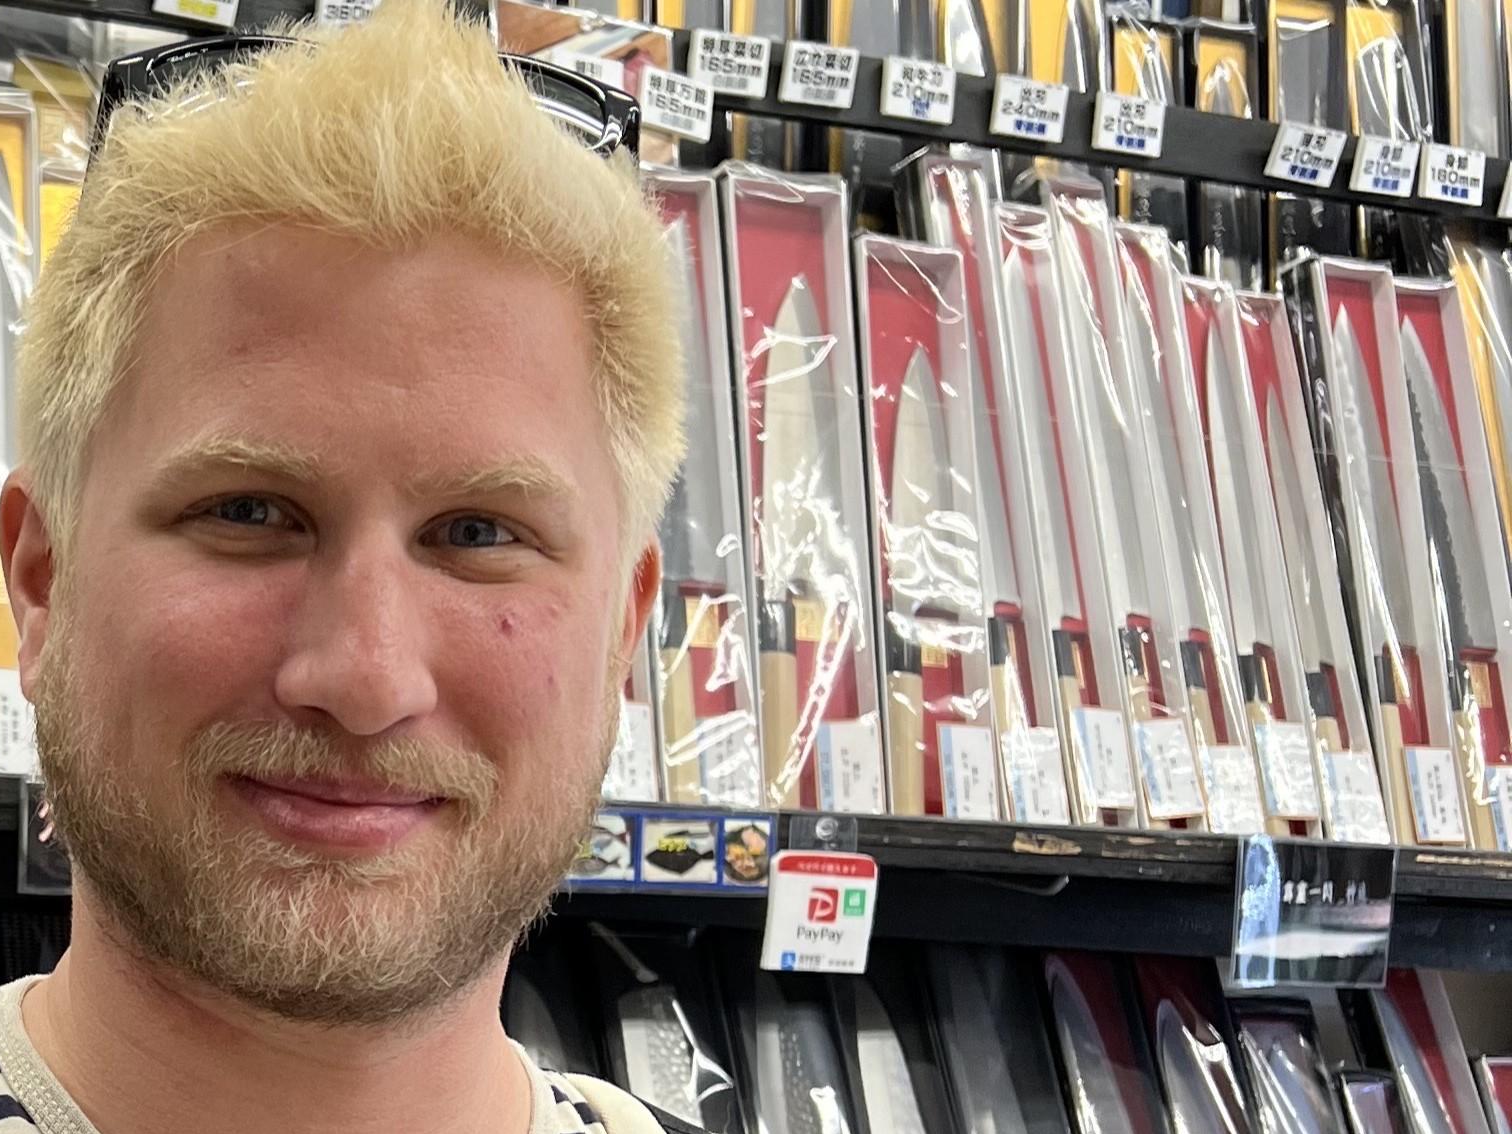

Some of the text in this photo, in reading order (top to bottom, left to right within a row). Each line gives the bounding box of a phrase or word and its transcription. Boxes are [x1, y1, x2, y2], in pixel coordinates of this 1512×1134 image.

[700, 54, 762, 77] 165mm
[792, 67, 849, 89] 165mm
[892, 81, 950, 105] 210mm
[648, 90, 706, 121] 165mm
[1001, 101, 1061, 122] 240mm
[1103, 115, 1159, 138] 210mm
[1280, 147, 1335, 169] 210mm
[1363, 160, 1412, 179] 210mm
[1430, 167, 1481, 188] 180mm
[796, 926, 844, 943] PayPay
